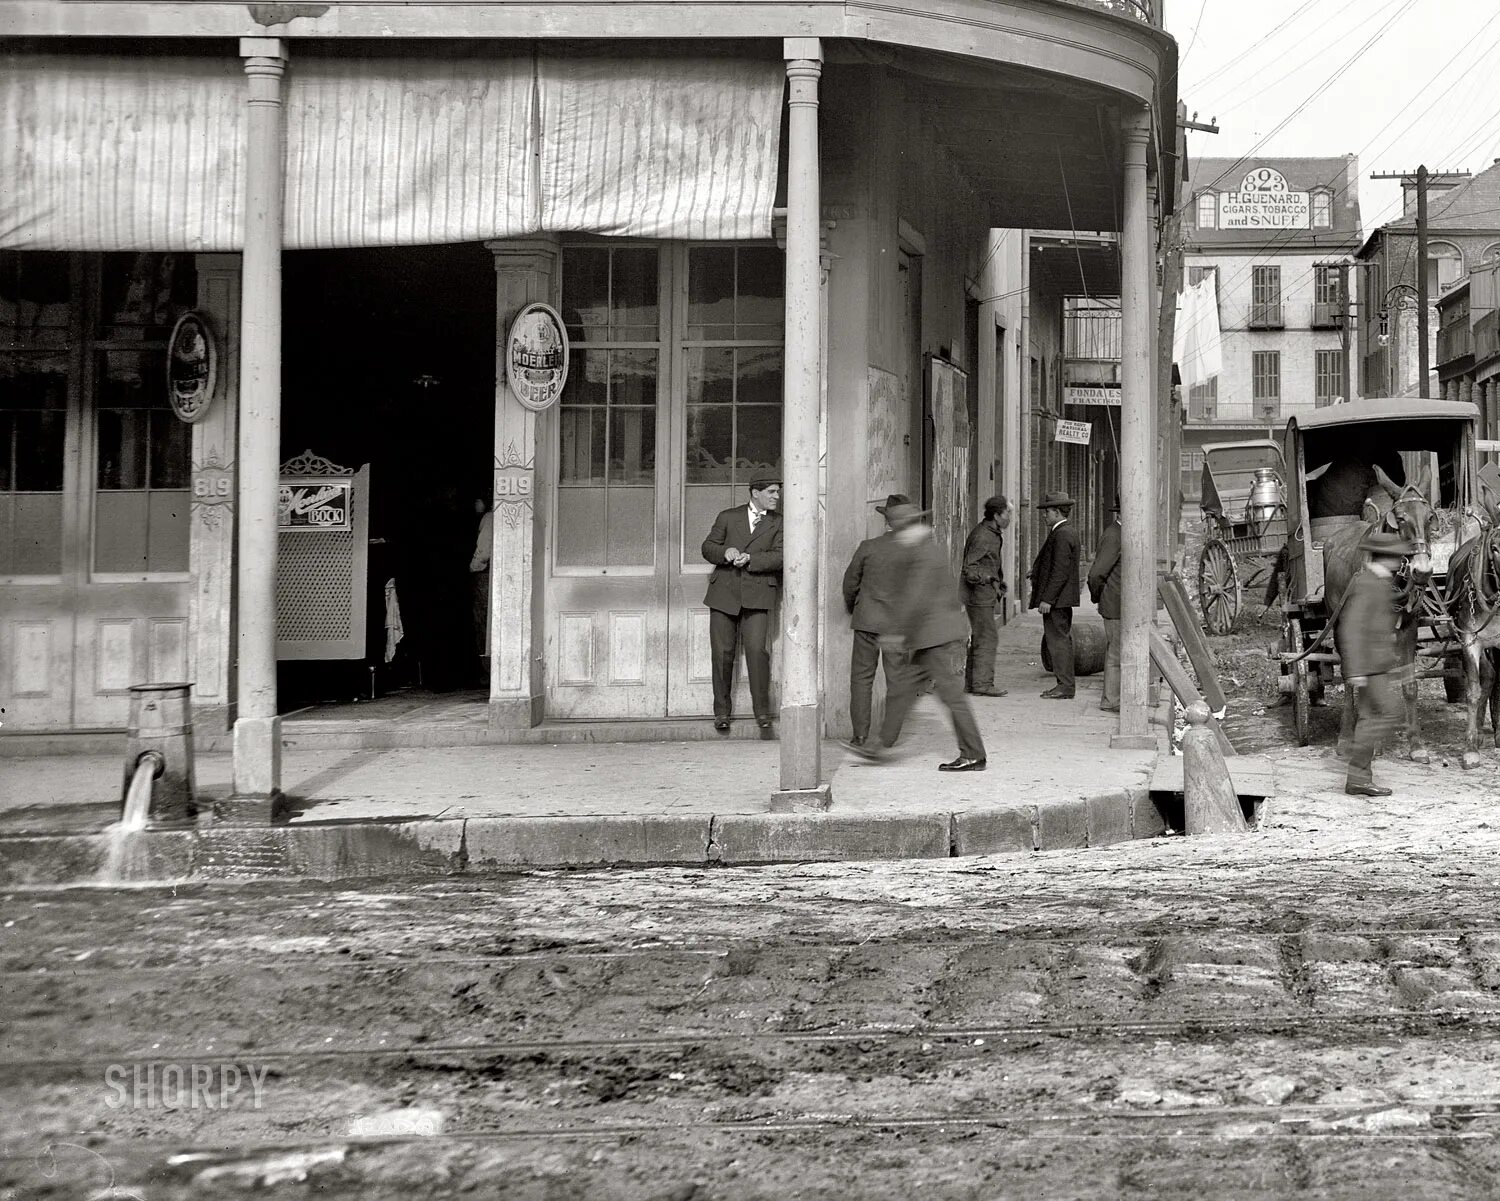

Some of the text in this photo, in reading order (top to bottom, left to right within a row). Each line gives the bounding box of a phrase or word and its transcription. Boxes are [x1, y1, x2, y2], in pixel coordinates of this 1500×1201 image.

[1244, 169, 1285, 192] 823
[1263, 205, 1307, 214] TOBACCO
[1227, 215, 1300, 226] and SNUFF
[520, 381, 556, 402] BEER
[1070, 389, 1103, 398] FONDA
[1058, 429, 1080, 437] REALTY
[195, 478, 229, 497] 819
[496, 477, 531, 495] 819
[311, 510, 340, 522] BOCK
